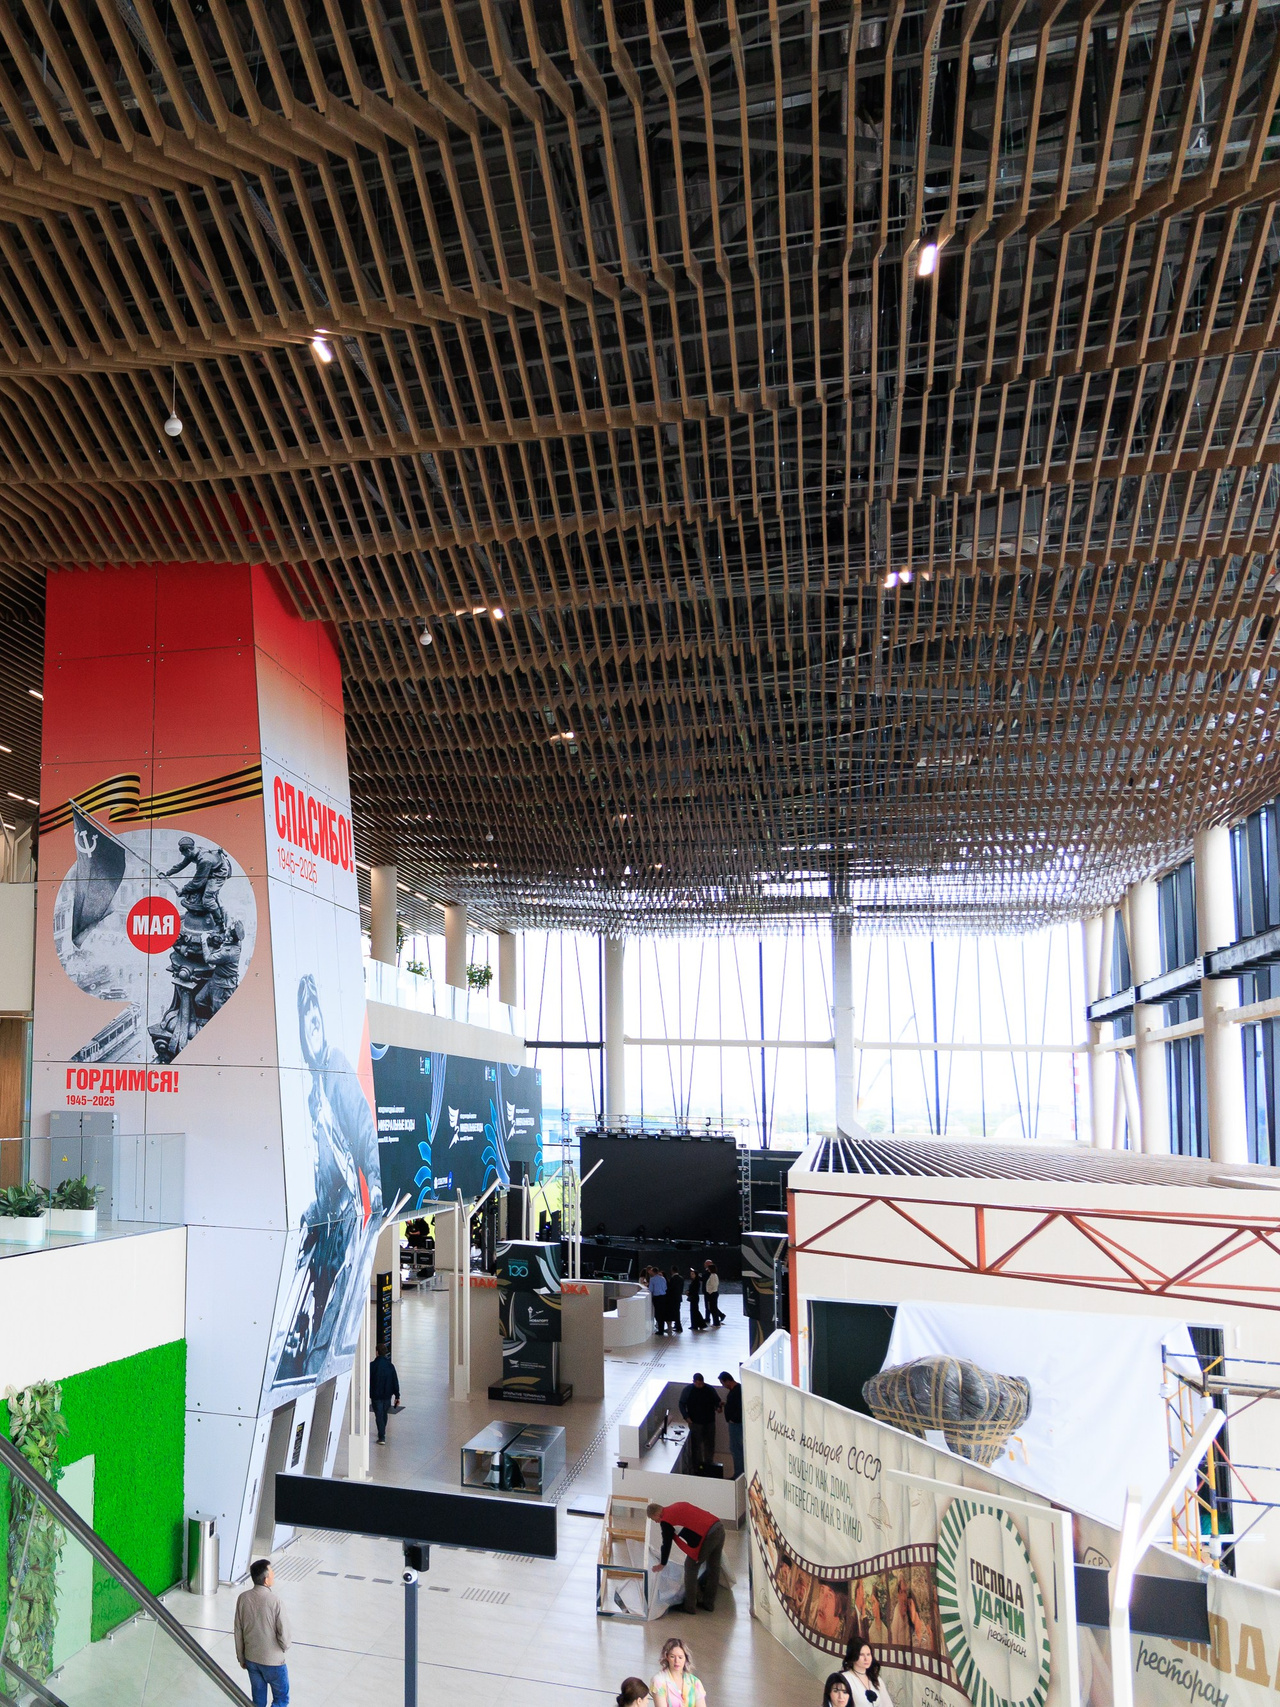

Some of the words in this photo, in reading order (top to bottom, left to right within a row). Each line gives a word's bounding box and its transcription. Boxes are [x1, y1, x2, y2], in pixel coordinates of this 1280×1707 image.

[273, 775, 354, 873] СПАСИБО!
[133, 915, 174, 935] МАЯ
[65, 1068, 179, 1093] ГОРДИМСЯ!
[766, 1410, 796, 1441] Кухня
[800, 1433, 843, 1465] народов
[847, 1446, 882, 1481] СССР
[788, 1454, 813, 1485] ВКУСНО
[815, 1467, 829, 1493] КАК
[783, 1479, 819, 1518] ИНТЕРЕСНО
[820, 1500, 835, 1528] КАК
[836, 1508, 841, 1531] В
[843, 1513, 862, 1543] КИНО
[970, 1557, 1024, 1610] ГОСПОДА
[971, 1583, 1026, 1639] УДАЧИ
[987, 1625, 1027, 1658] ресторан
[1135, 1639, 1230, 1707] ресторан
